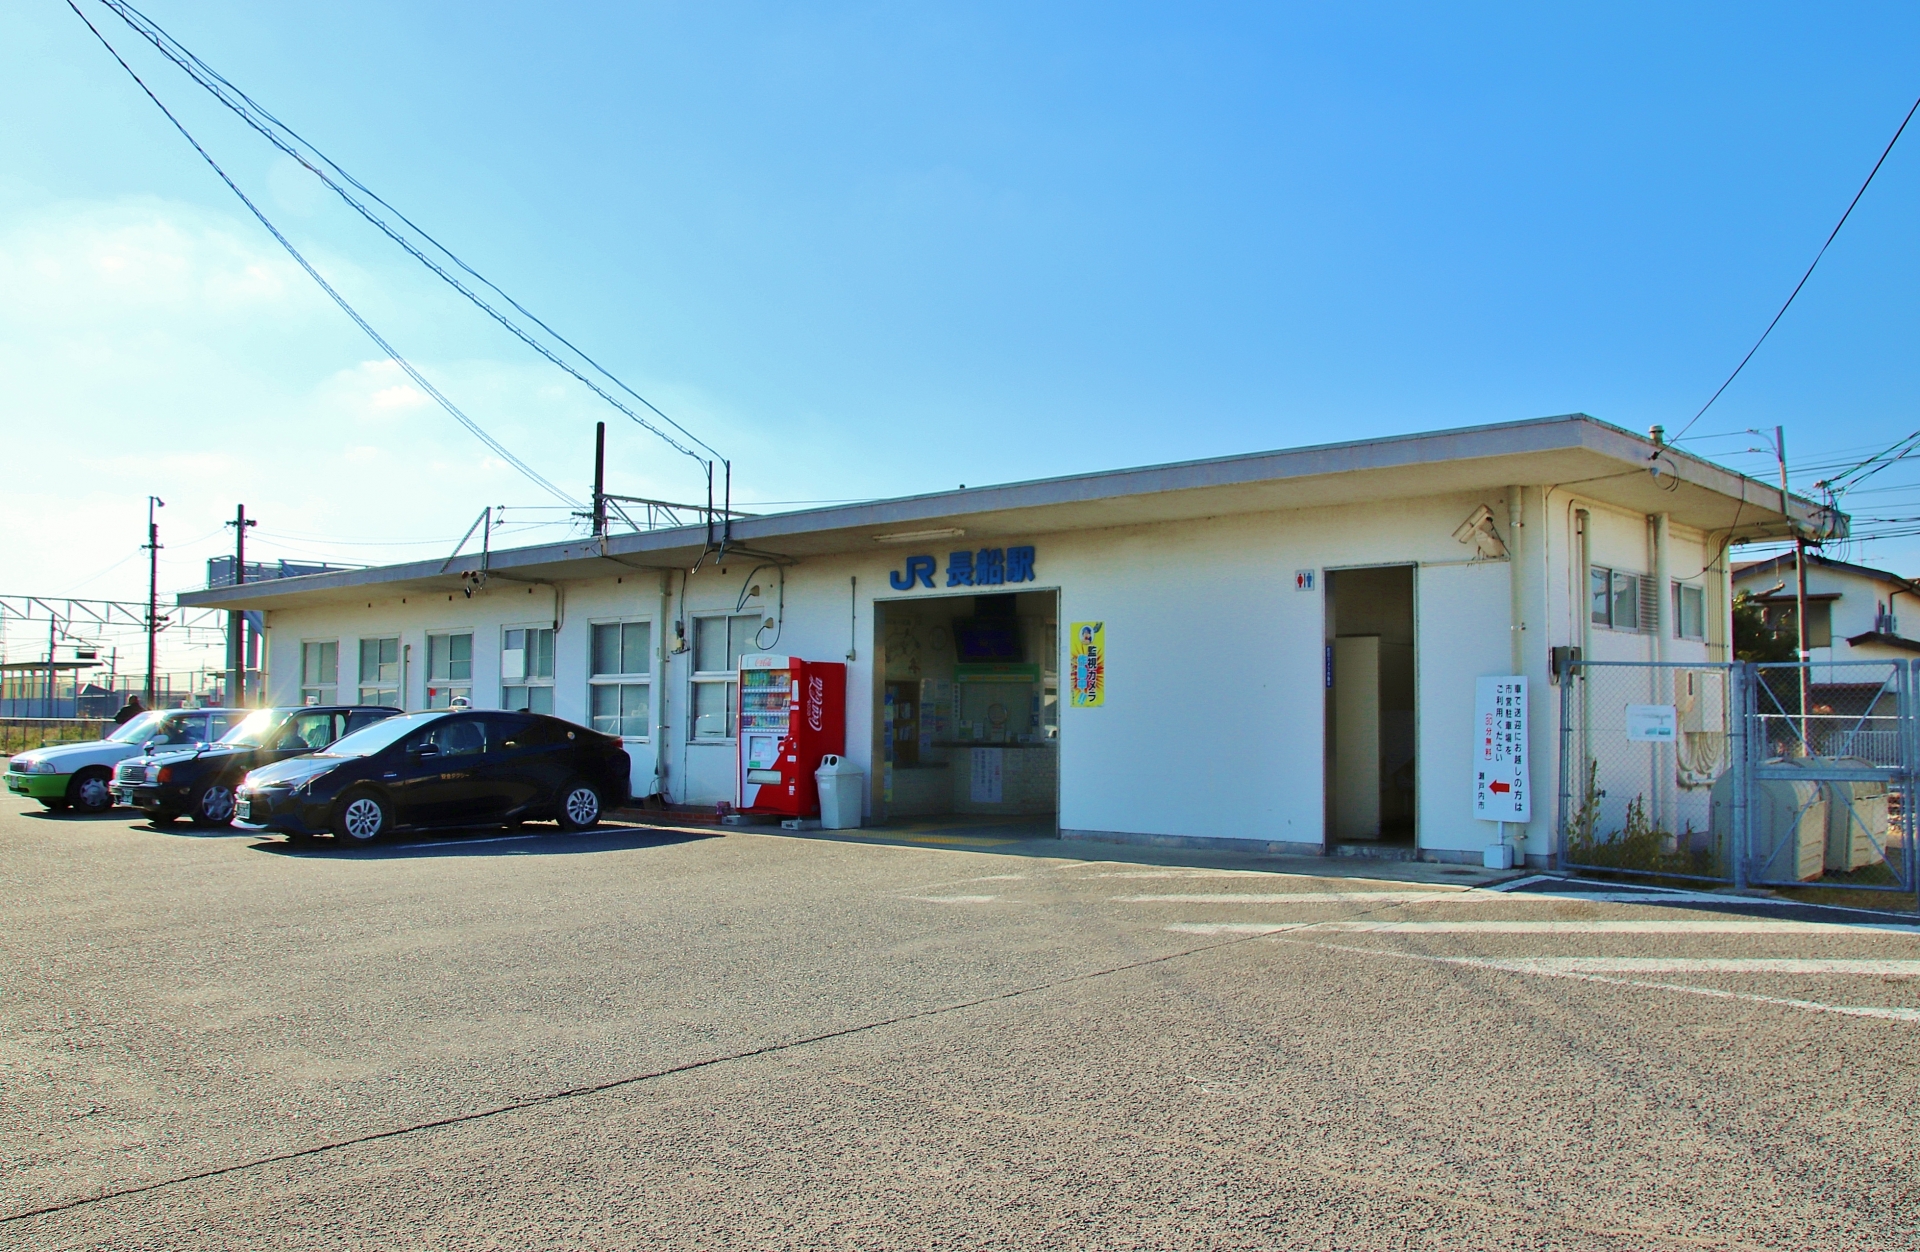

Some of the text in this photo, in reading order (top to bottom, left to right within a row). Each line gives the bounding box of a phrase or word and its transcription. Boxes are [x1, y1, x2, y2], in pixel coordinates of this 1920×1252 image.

[890, 545, 1036, 591] JR 長船駅
[1088, 645, 1097, 702] 監視カメラ
[1495, 684, 1503, 762] ご利用ください
[1514, 684, 1522, 812] 車で送迎にお越しの方は
